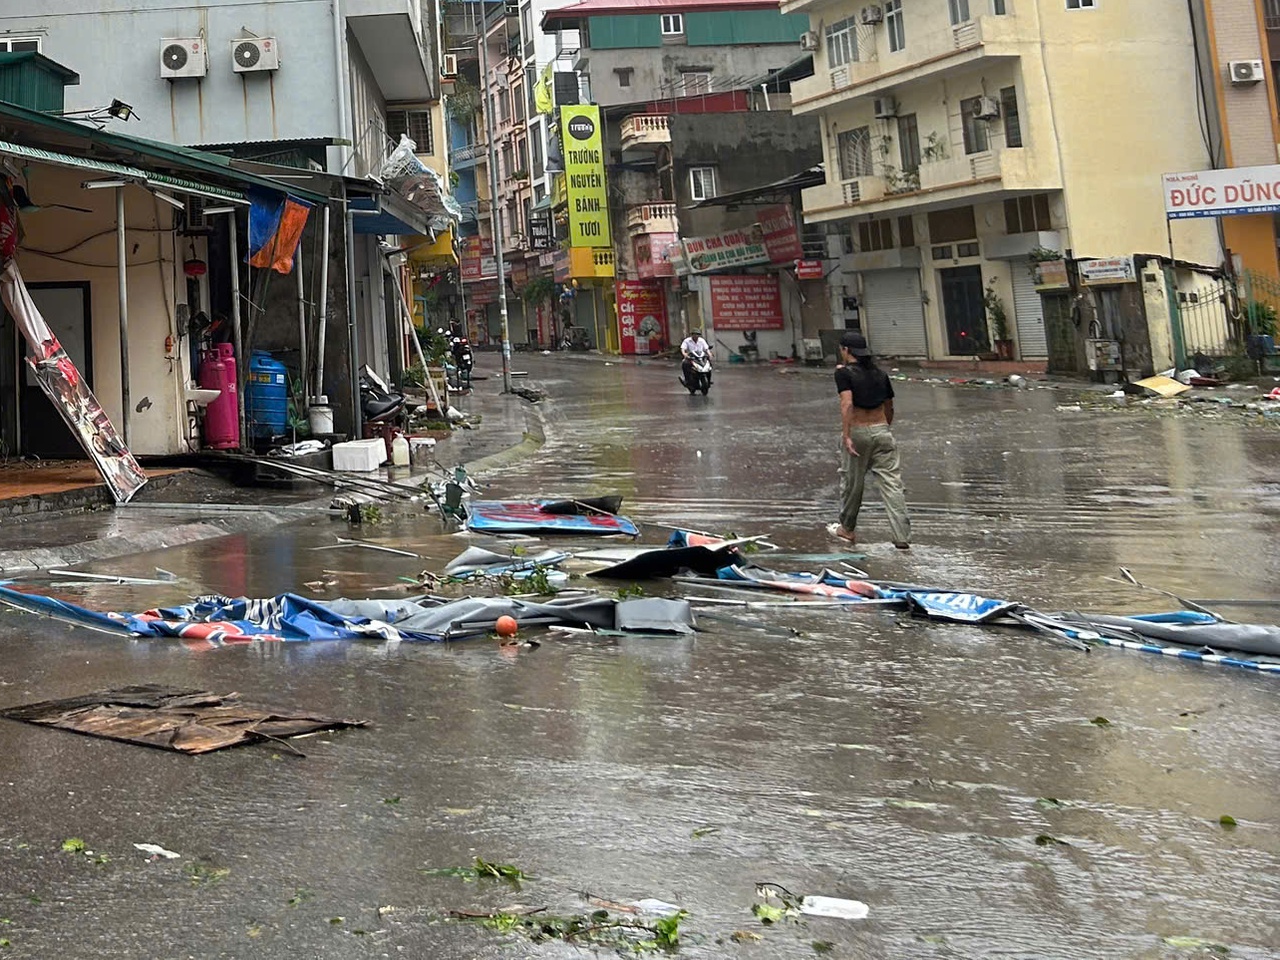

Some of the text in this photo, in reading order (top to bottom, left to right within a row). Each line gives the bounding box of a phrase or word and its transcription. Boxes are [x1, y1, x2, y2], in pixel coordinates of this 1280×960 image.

[569, 147, 600, 164] TRƯỜNG
[576, 195, 600, 212] BÁNH
[1170, 183, 1216, 207] ĐỨC
[579, 222, 601, 236] TƯƠI
